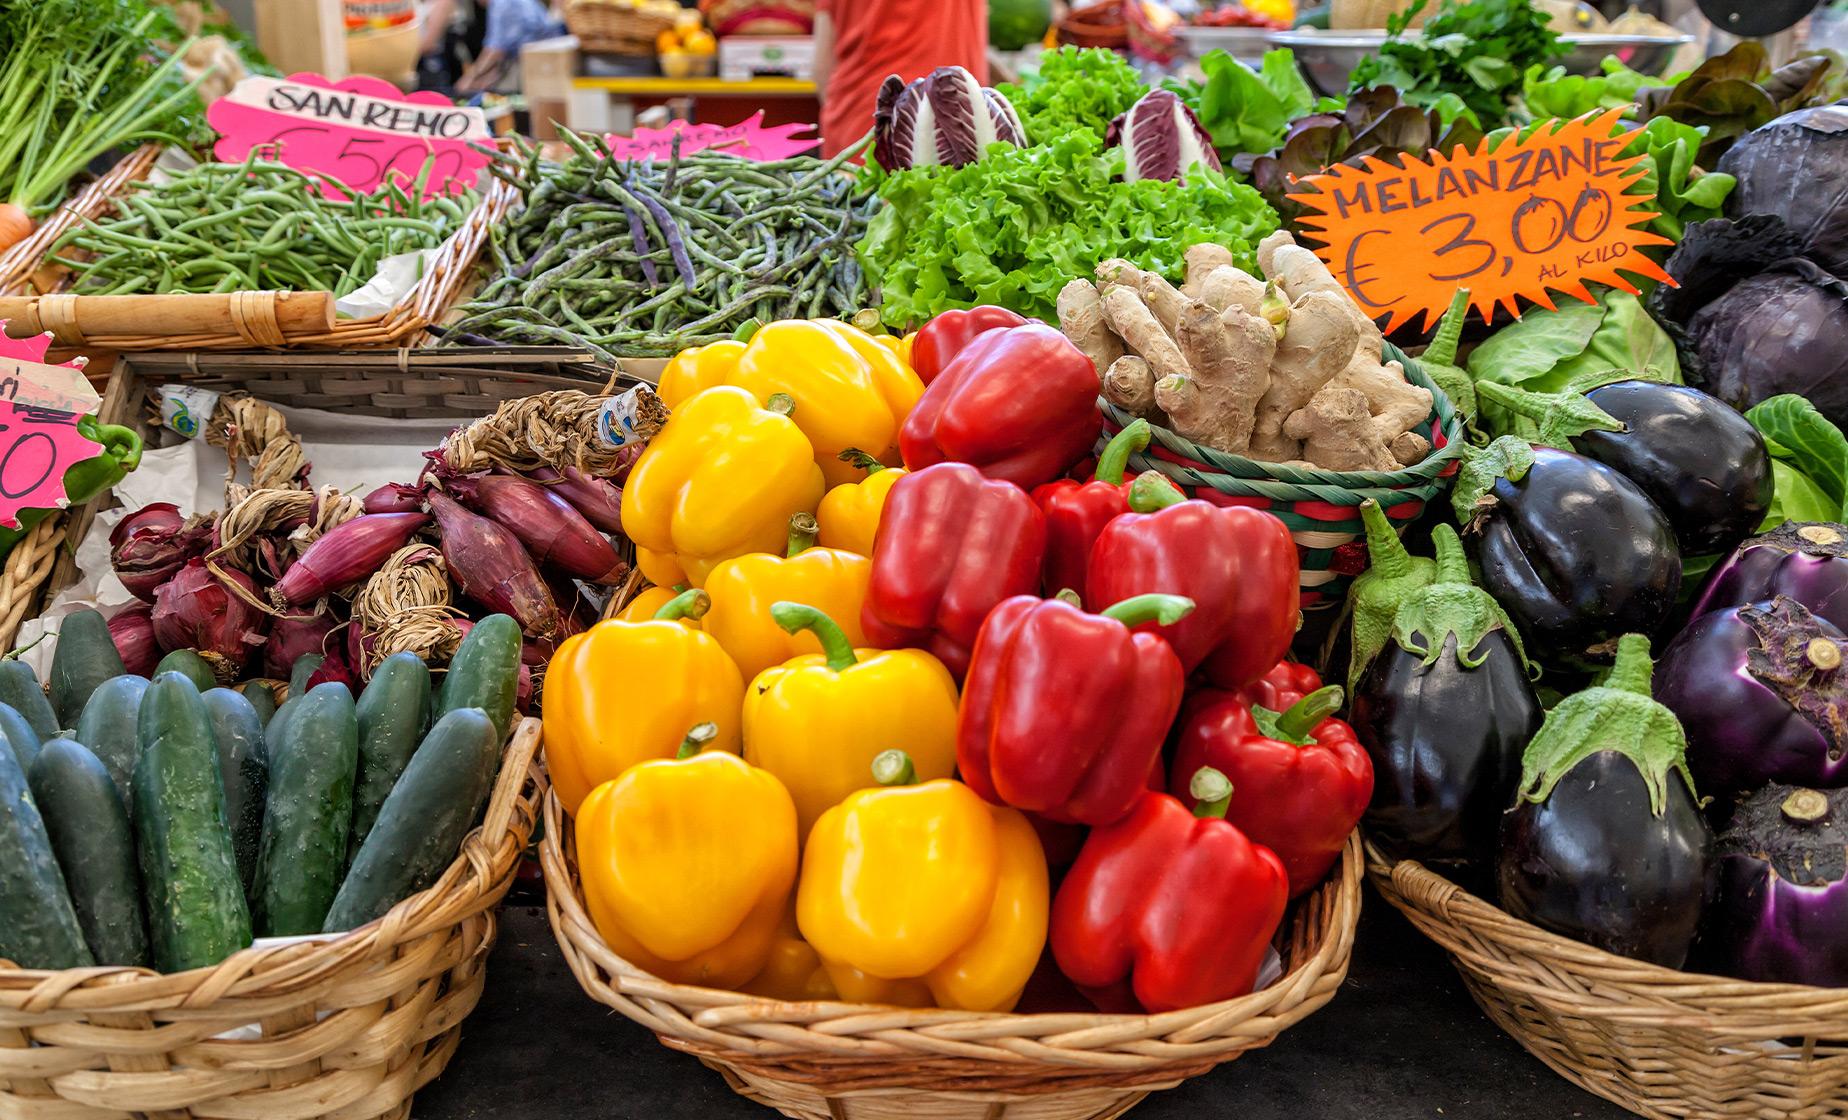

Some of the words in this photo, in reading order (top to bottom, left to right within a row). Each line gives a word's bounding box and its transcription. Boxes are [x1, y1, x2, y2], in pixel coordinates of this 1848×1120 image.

[268, 85, 357, 119] SAN
[363, 102, 470, 138] REMO
[1333, 138, 1625, 219] MELANZANE
[1339, 229, 1407, 307] €
[1420, 182, 1612, 281] 3,00
[1538, 263, 1568, 281] AL
[1576, 241, 1628, 269] KILO
